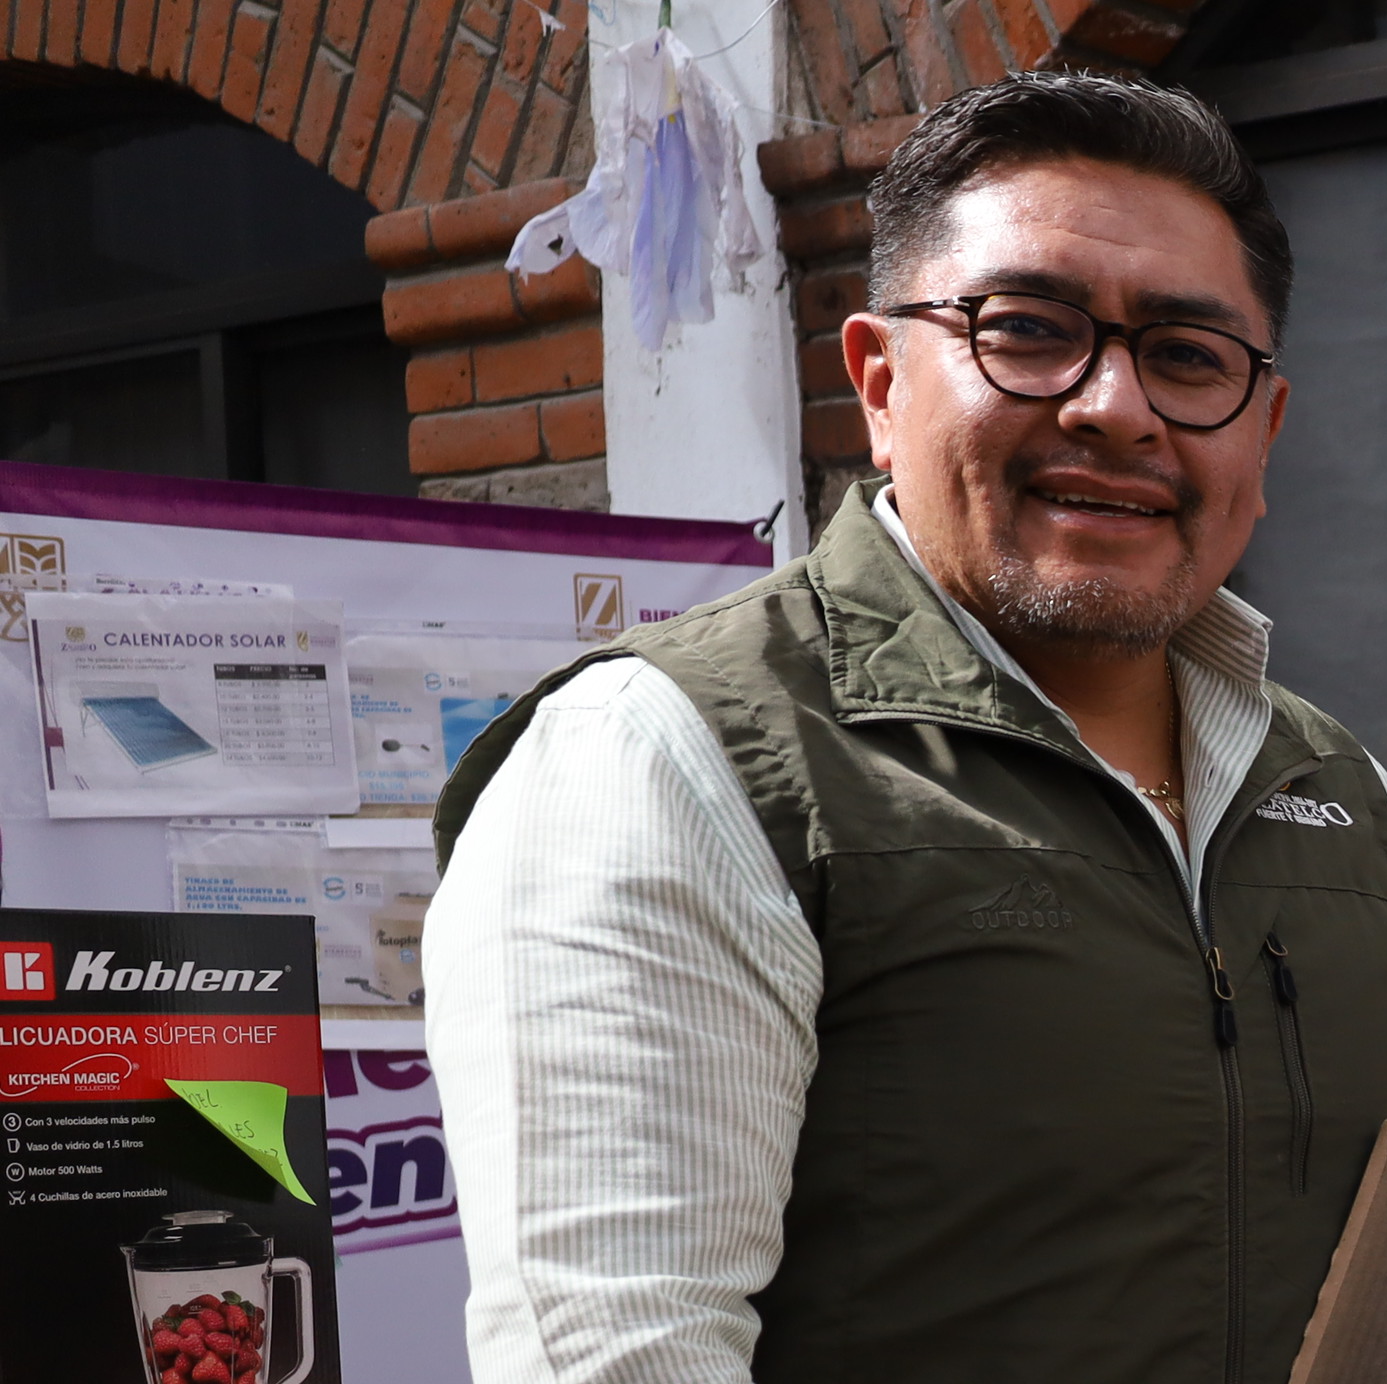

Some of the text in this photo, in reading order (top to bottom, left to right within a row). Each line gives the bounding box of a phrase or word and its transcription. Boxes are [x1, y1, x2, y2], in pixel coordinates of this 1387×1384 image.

[640, 609, 685, 623] BIE
[104, 632, 224, 648] CALENTADOR
[230, 634, 287, 648] SOLAR
[971, 910, 1072, 930] OUTDOOR
[65, 950, 284, 993] Koblenz
[0, 1022, 278, 1046] LICUADORA SÚPER CHEF
[8, 1072, 120, 1086] KITCHEN MAGIC
[25, 1117, 44, 1127] Con
[46, 1117, 53, 1127] 3
[54, 1115, 109, 1127] velocidades
[111, 1115, 130, 1125] más
[132, 1114, 156, 1127] pulso
[26, 1139, 144, 1152] Vaso de vidrio de 1.5 litros
[28, 1166, 56, 1177] Motor
[58, 1166, 75, 1175] 500
[77, 1164, 103, 1175] Watts
[30, 1187, 168, 1202] 4 Cuchillas de acero inoxidable
